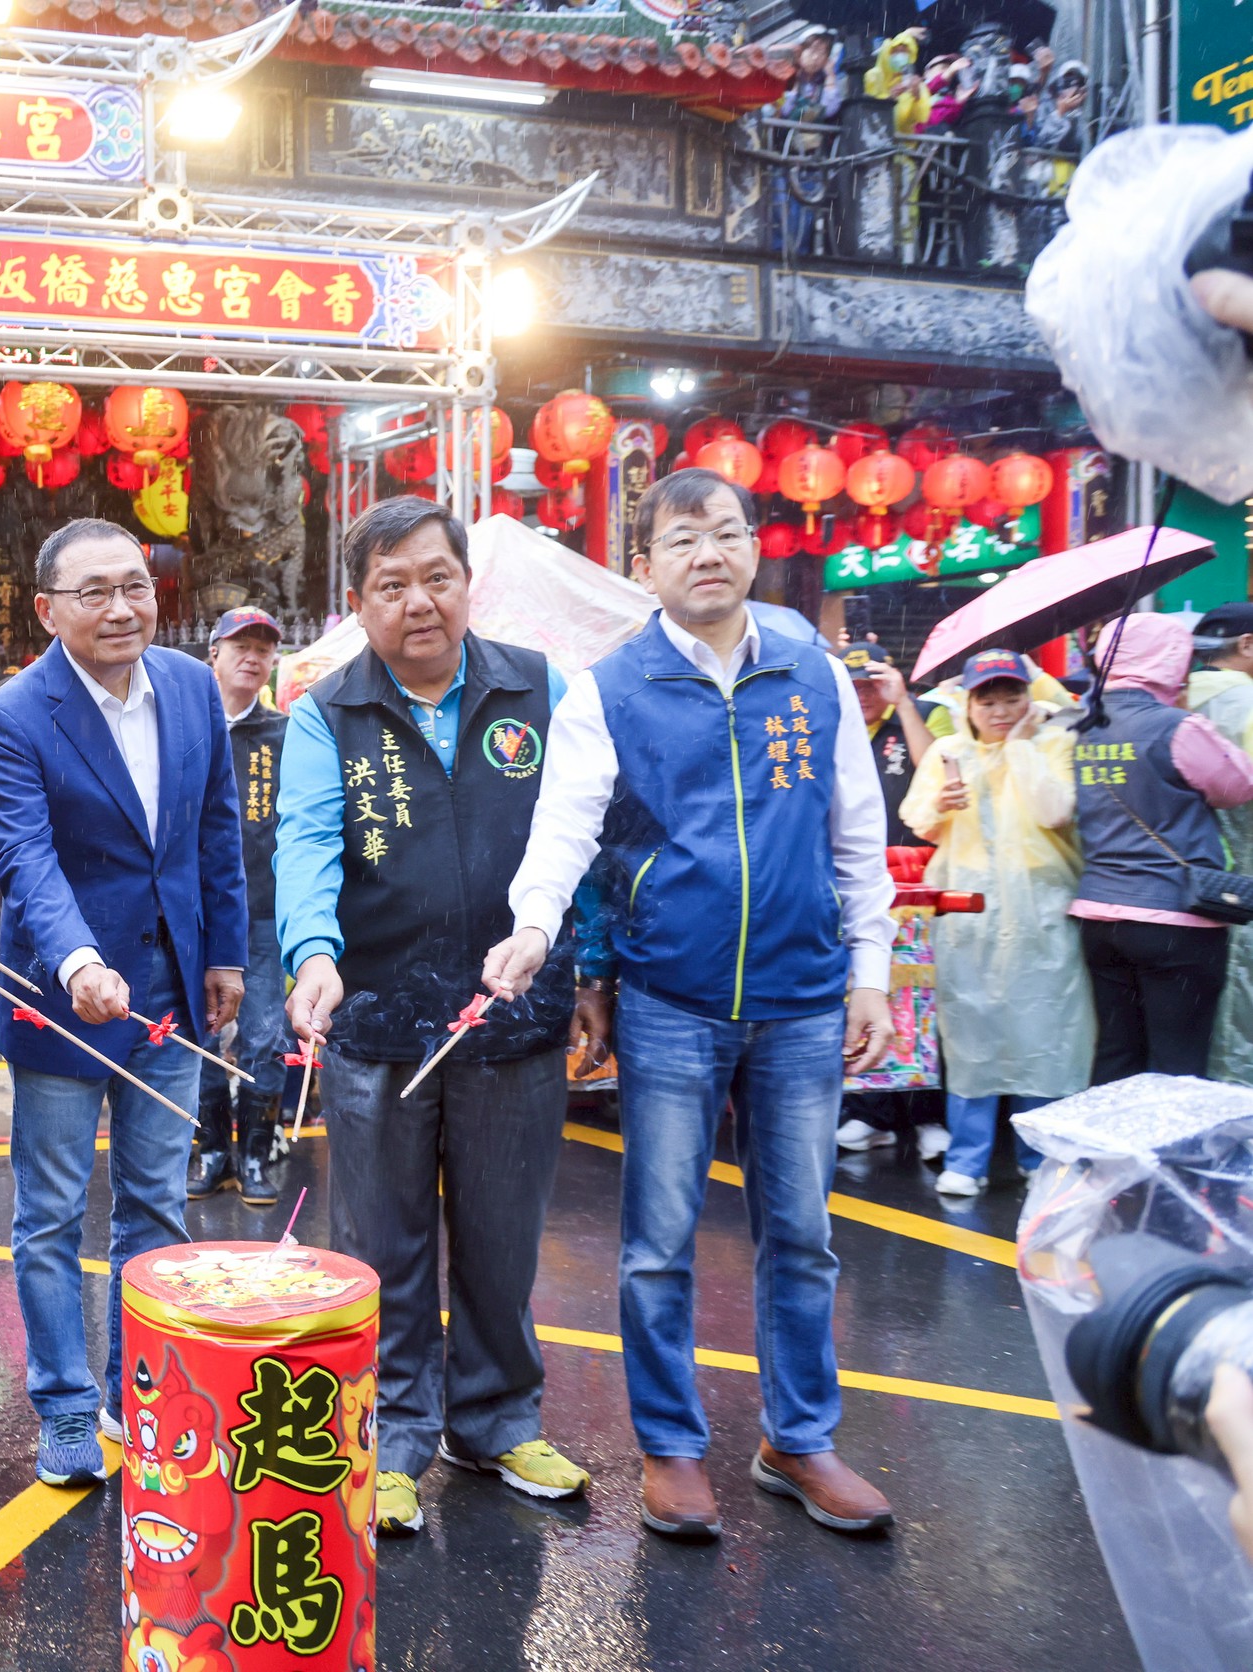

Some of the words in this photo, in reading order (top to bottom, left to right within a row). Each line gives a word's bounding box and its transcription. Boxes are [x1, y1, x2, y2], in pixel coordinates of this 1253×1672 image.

[381, 728, 413, 828] 主任委員
[764, 715, 792, 789] 林耀長
[790, 695, 816, 780] 民政局長
[345, 757, 389, 866] 洪文華
[229, 1355, 353, 1657] 起馬
